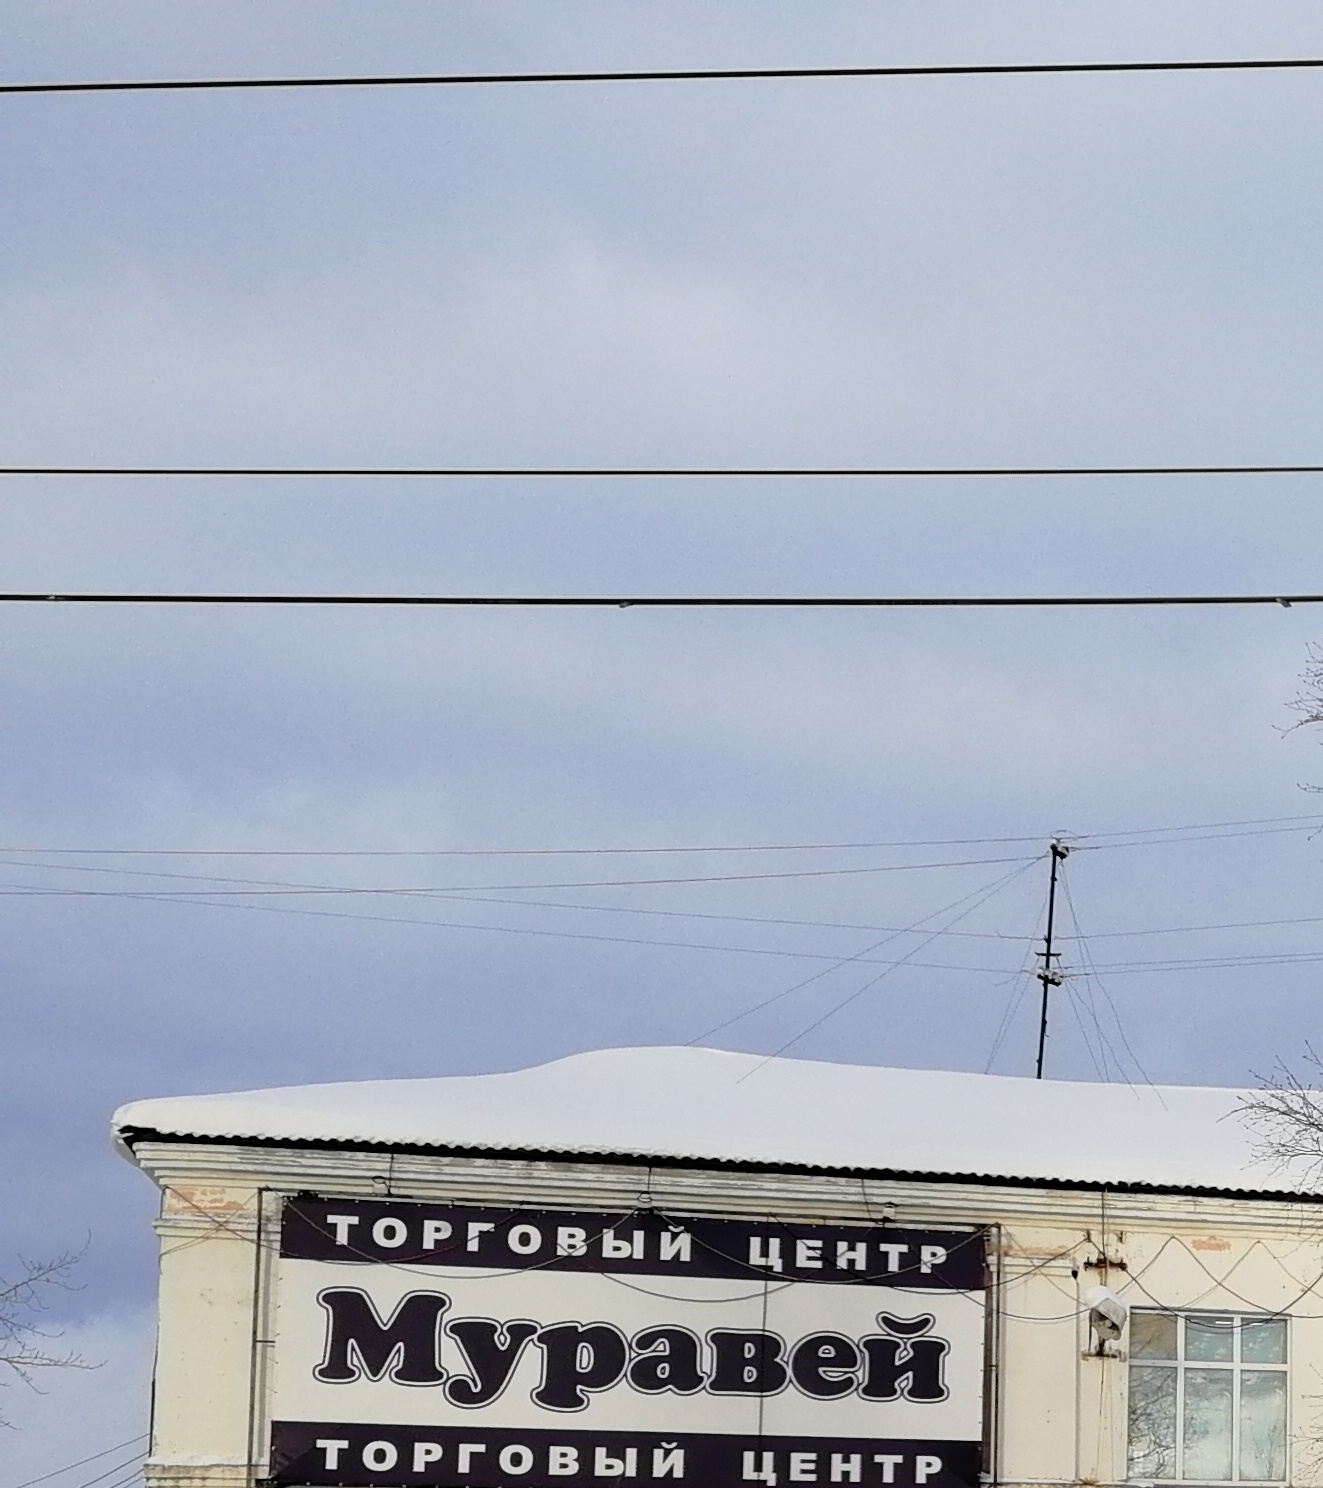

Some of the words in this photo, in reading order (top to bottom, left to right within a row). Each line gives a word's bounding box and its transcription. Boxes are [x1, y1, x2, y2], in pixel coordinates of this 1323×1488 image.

[326, 1214, 692, 1262] ТОРГОВЫЙ
[749, 1236, 947, 1274] ЦЕНТР
[312, 1286, 951, 1413] Муравей
[316, 1439, 685, 1479] ТОРГОВЫЙ
[742, 1451, 943, 1486] ЦЕНТР
